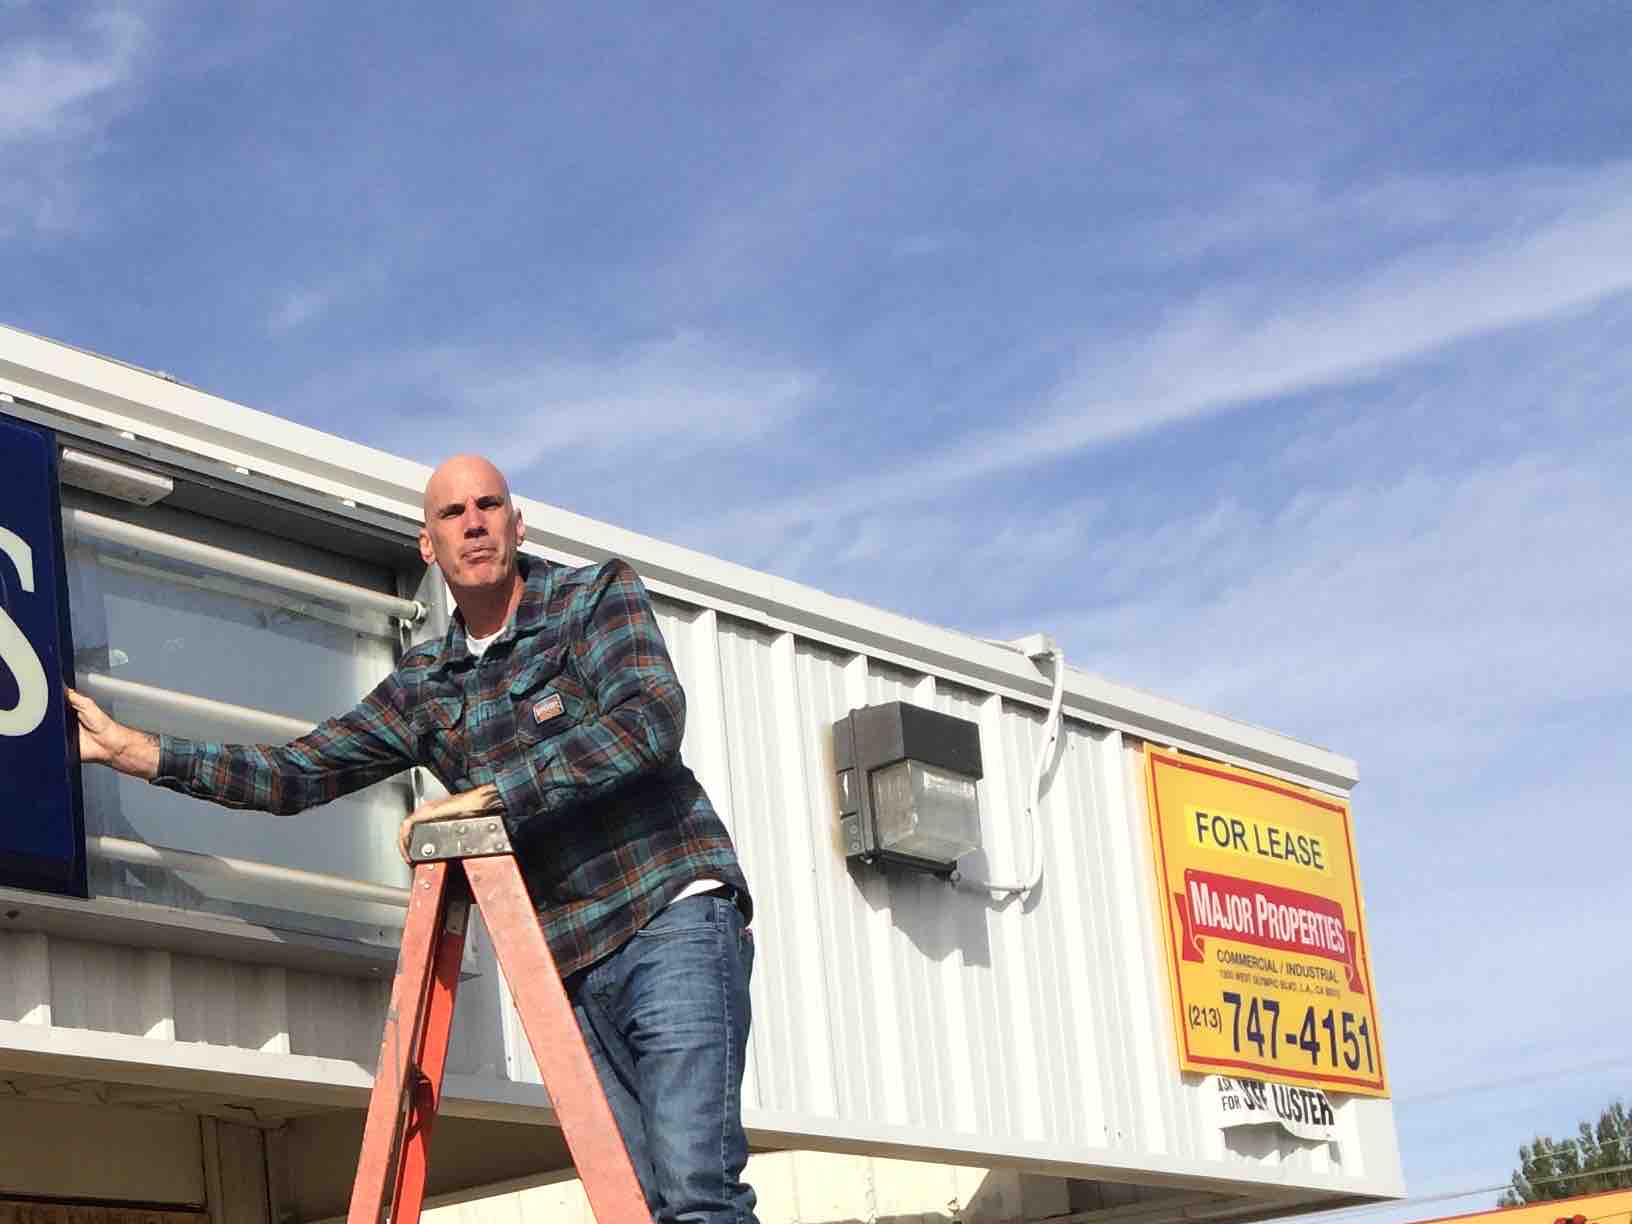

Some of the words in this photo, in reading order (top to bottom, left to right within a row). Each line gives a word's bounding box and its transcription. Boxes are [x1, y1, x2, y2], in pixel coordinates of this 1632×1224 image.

[1195, 811, 1248, 852] FOR
[1253, 823, 1325, 870] LEASE
[1189, 880, 1255, 936] MAJOR
[1254, 893, 1345, 954] PROPERTIES
[1216, 949, 1278, 973] COMMERCIAL
[1286, 962, 1340, 983] INDUSTRIAL
[1188, 1003, 1223, 1032] (213)
[1222, 991, 1374, 1074] 747-4151
[1222, 1095, 1241, 1111] FOR
[1271, 1084, 1335, 1126] LUSTER
